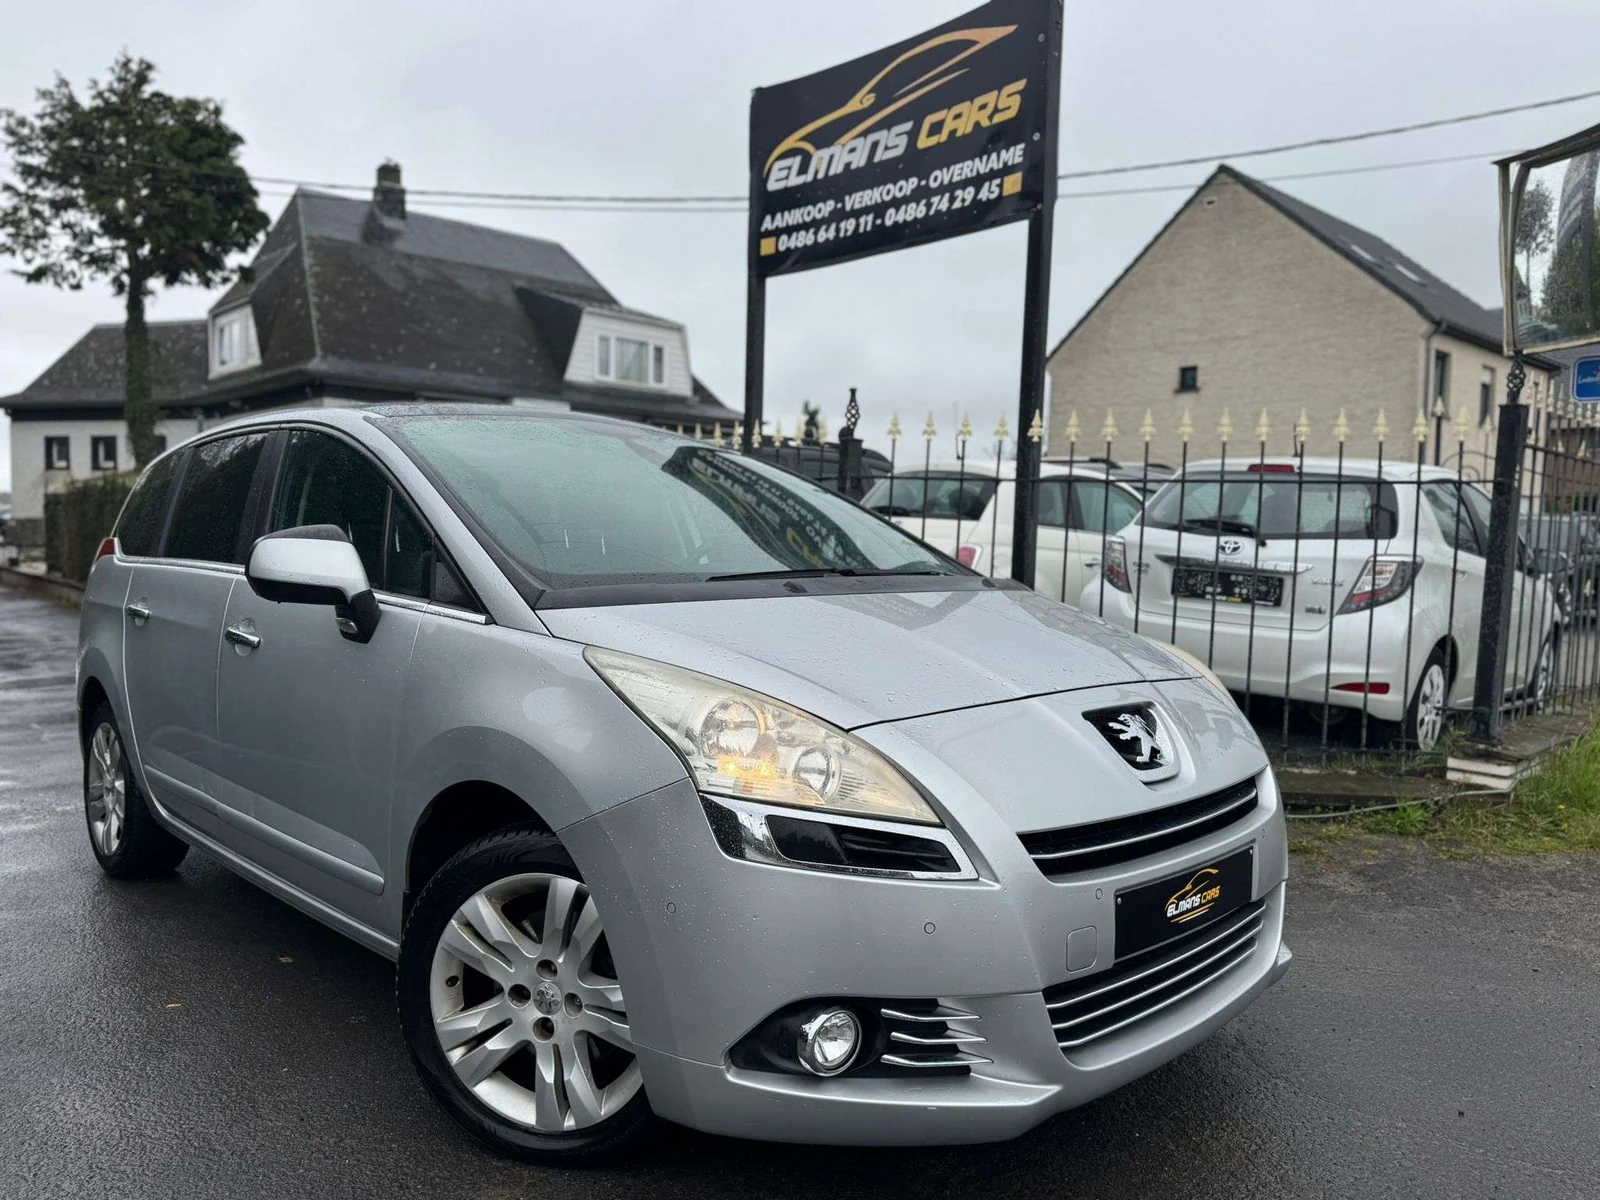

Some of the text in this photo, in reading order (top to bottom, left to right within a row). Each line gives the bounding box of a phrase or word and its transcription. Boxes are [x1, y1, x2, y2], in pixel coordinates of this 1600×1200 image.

[766, 78, 1027, 192] ELMANS CARS
[760, 199, 836, 233] AANKOOP
[844, 177, 918, 212] VERKOOP
[928, 142, 1026, 189] OVERNAME
[777, 228, 816, 252] 0486
[817, 222, 837, 243] 64
[838, 218, 857, 238] 19
[858, 213, 875, 233] 11
[884, 199, 927, 227] 0486
[928, 192, 951, 216] 74
[951, 186, 976, 210] 29
[976, 177, 1002, 202] 45
[1167, 885, 1221, 917] ELMANS CARS
